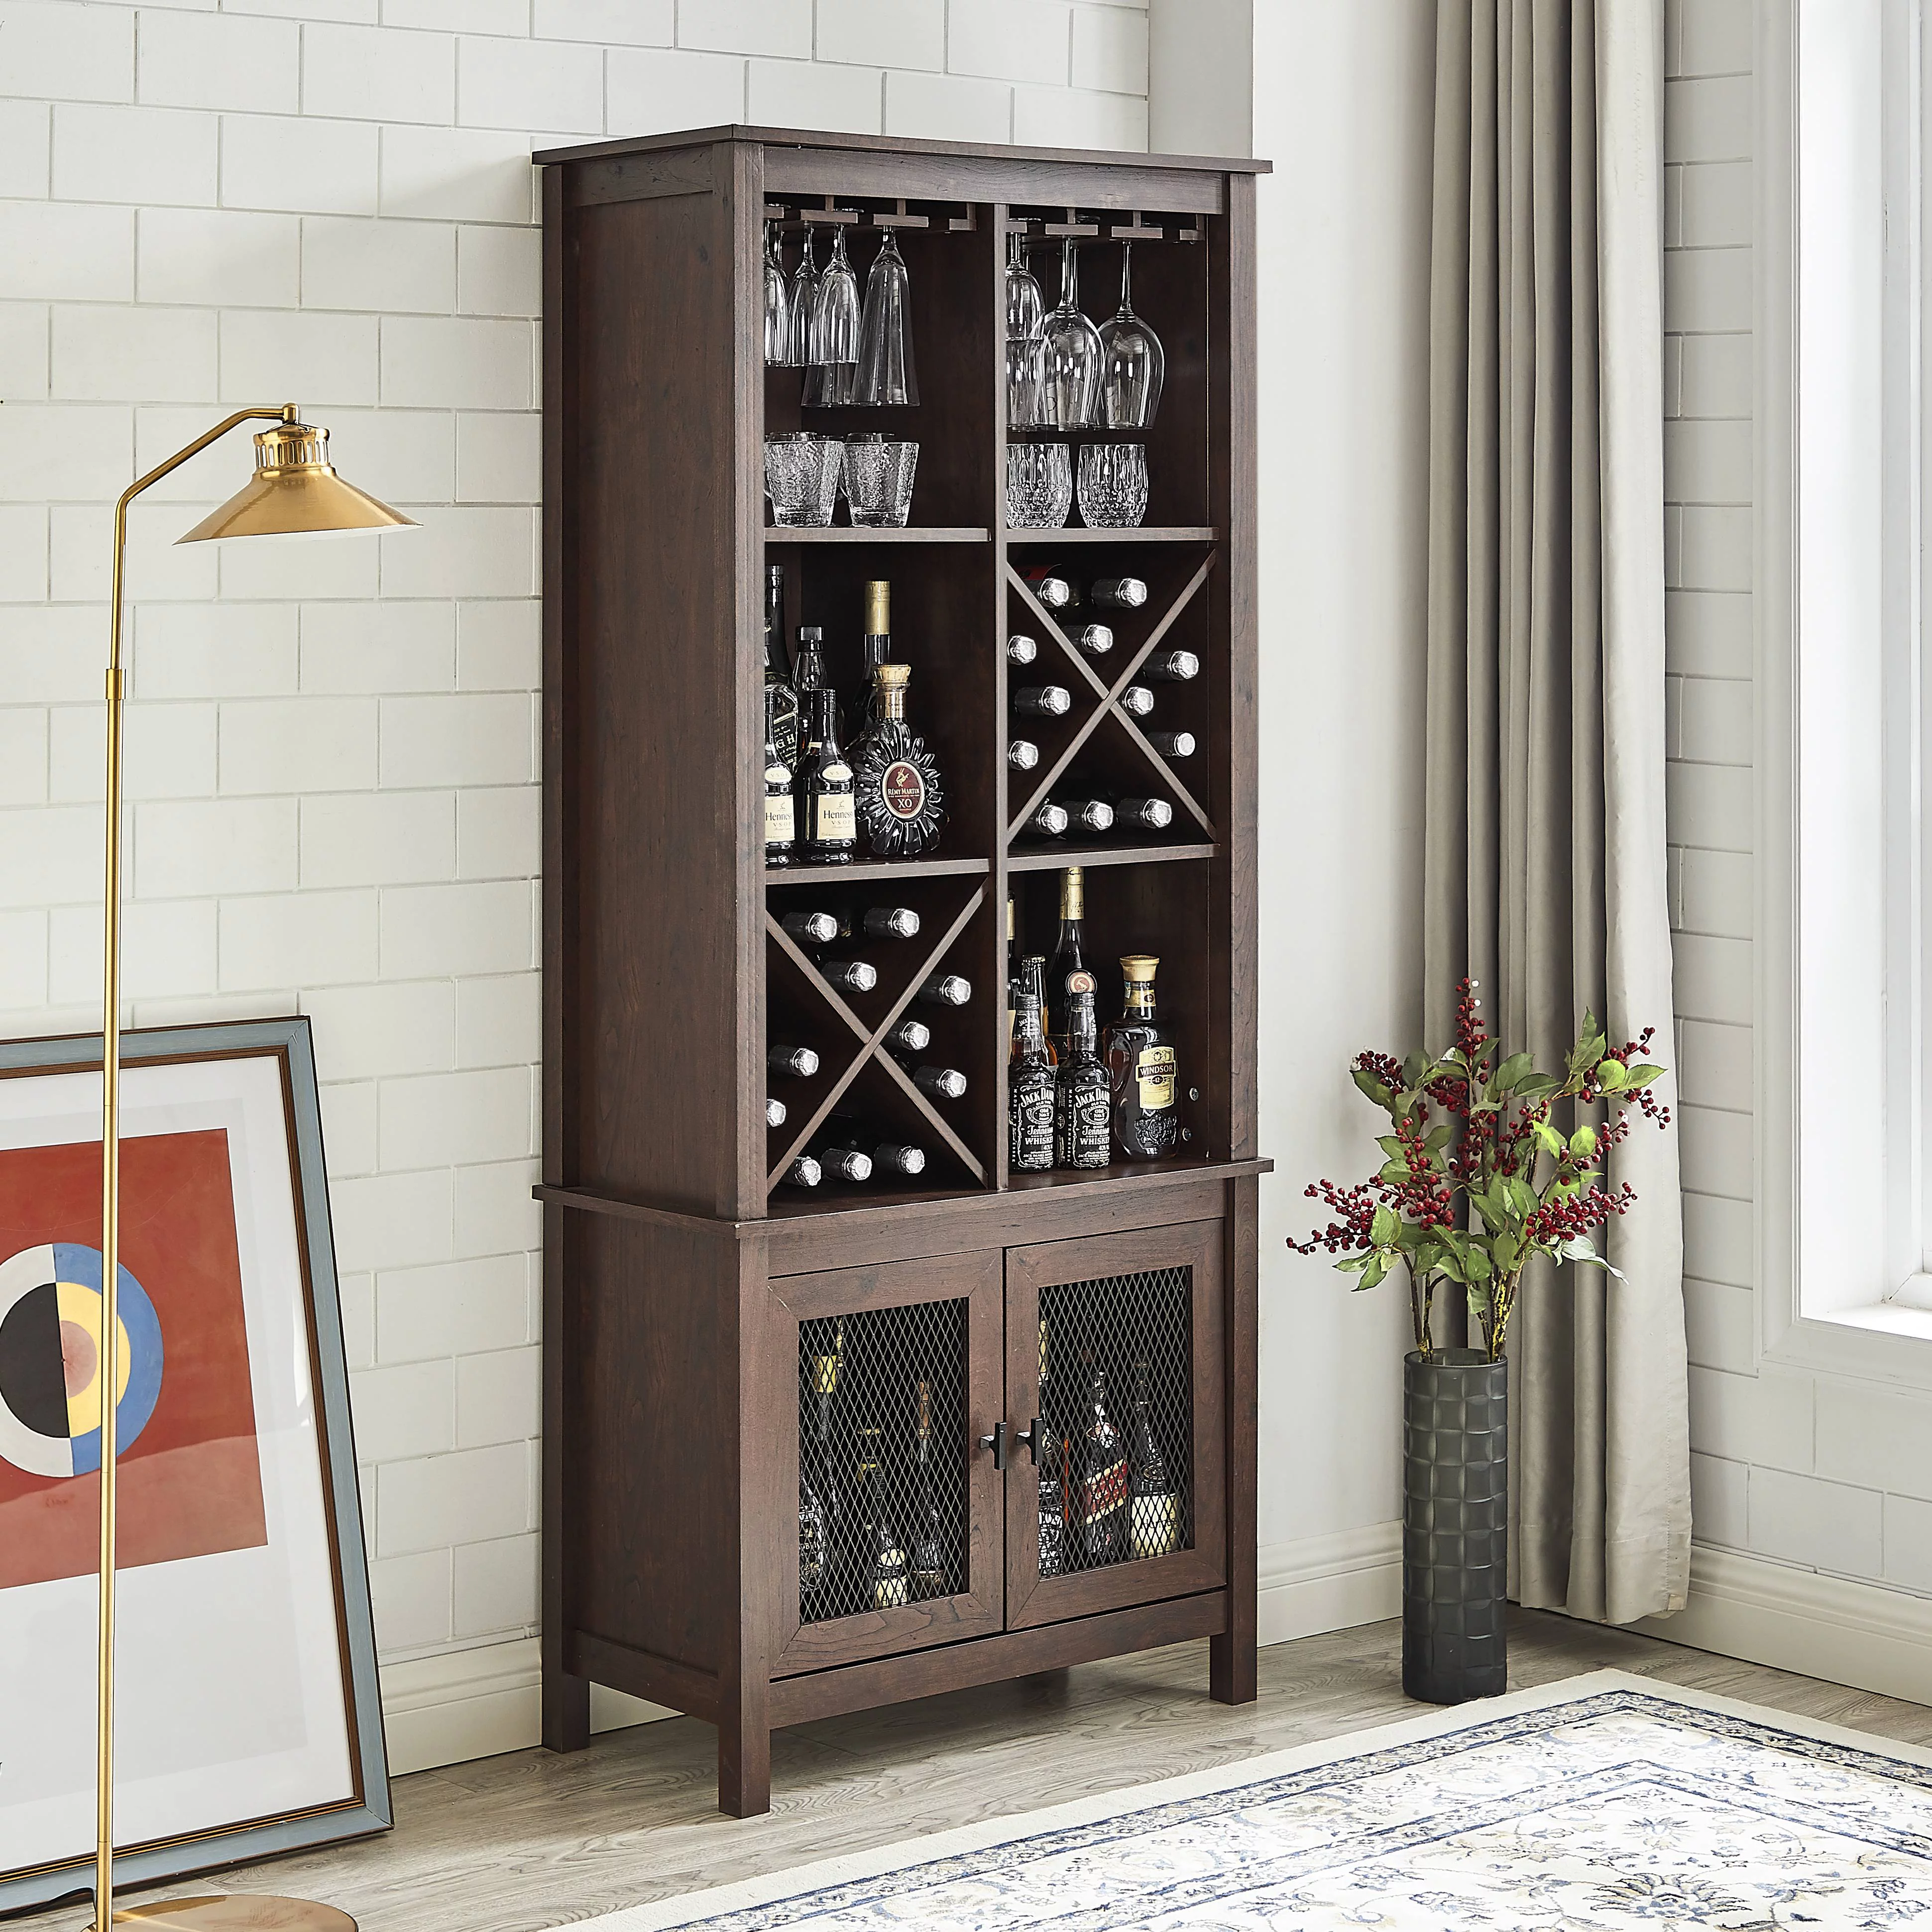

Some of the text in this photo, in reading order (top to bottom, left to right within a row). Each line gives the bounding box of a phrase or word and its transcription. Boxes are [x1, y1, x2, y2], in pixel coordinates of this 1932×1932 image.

[897, 798, 912, 808] XO
[1139, 1065, 1173, 1076] WINDSOR
[1020, 1091, 1041, 1108] JACK
[1075, 1091, 1096, 1108] JACK
